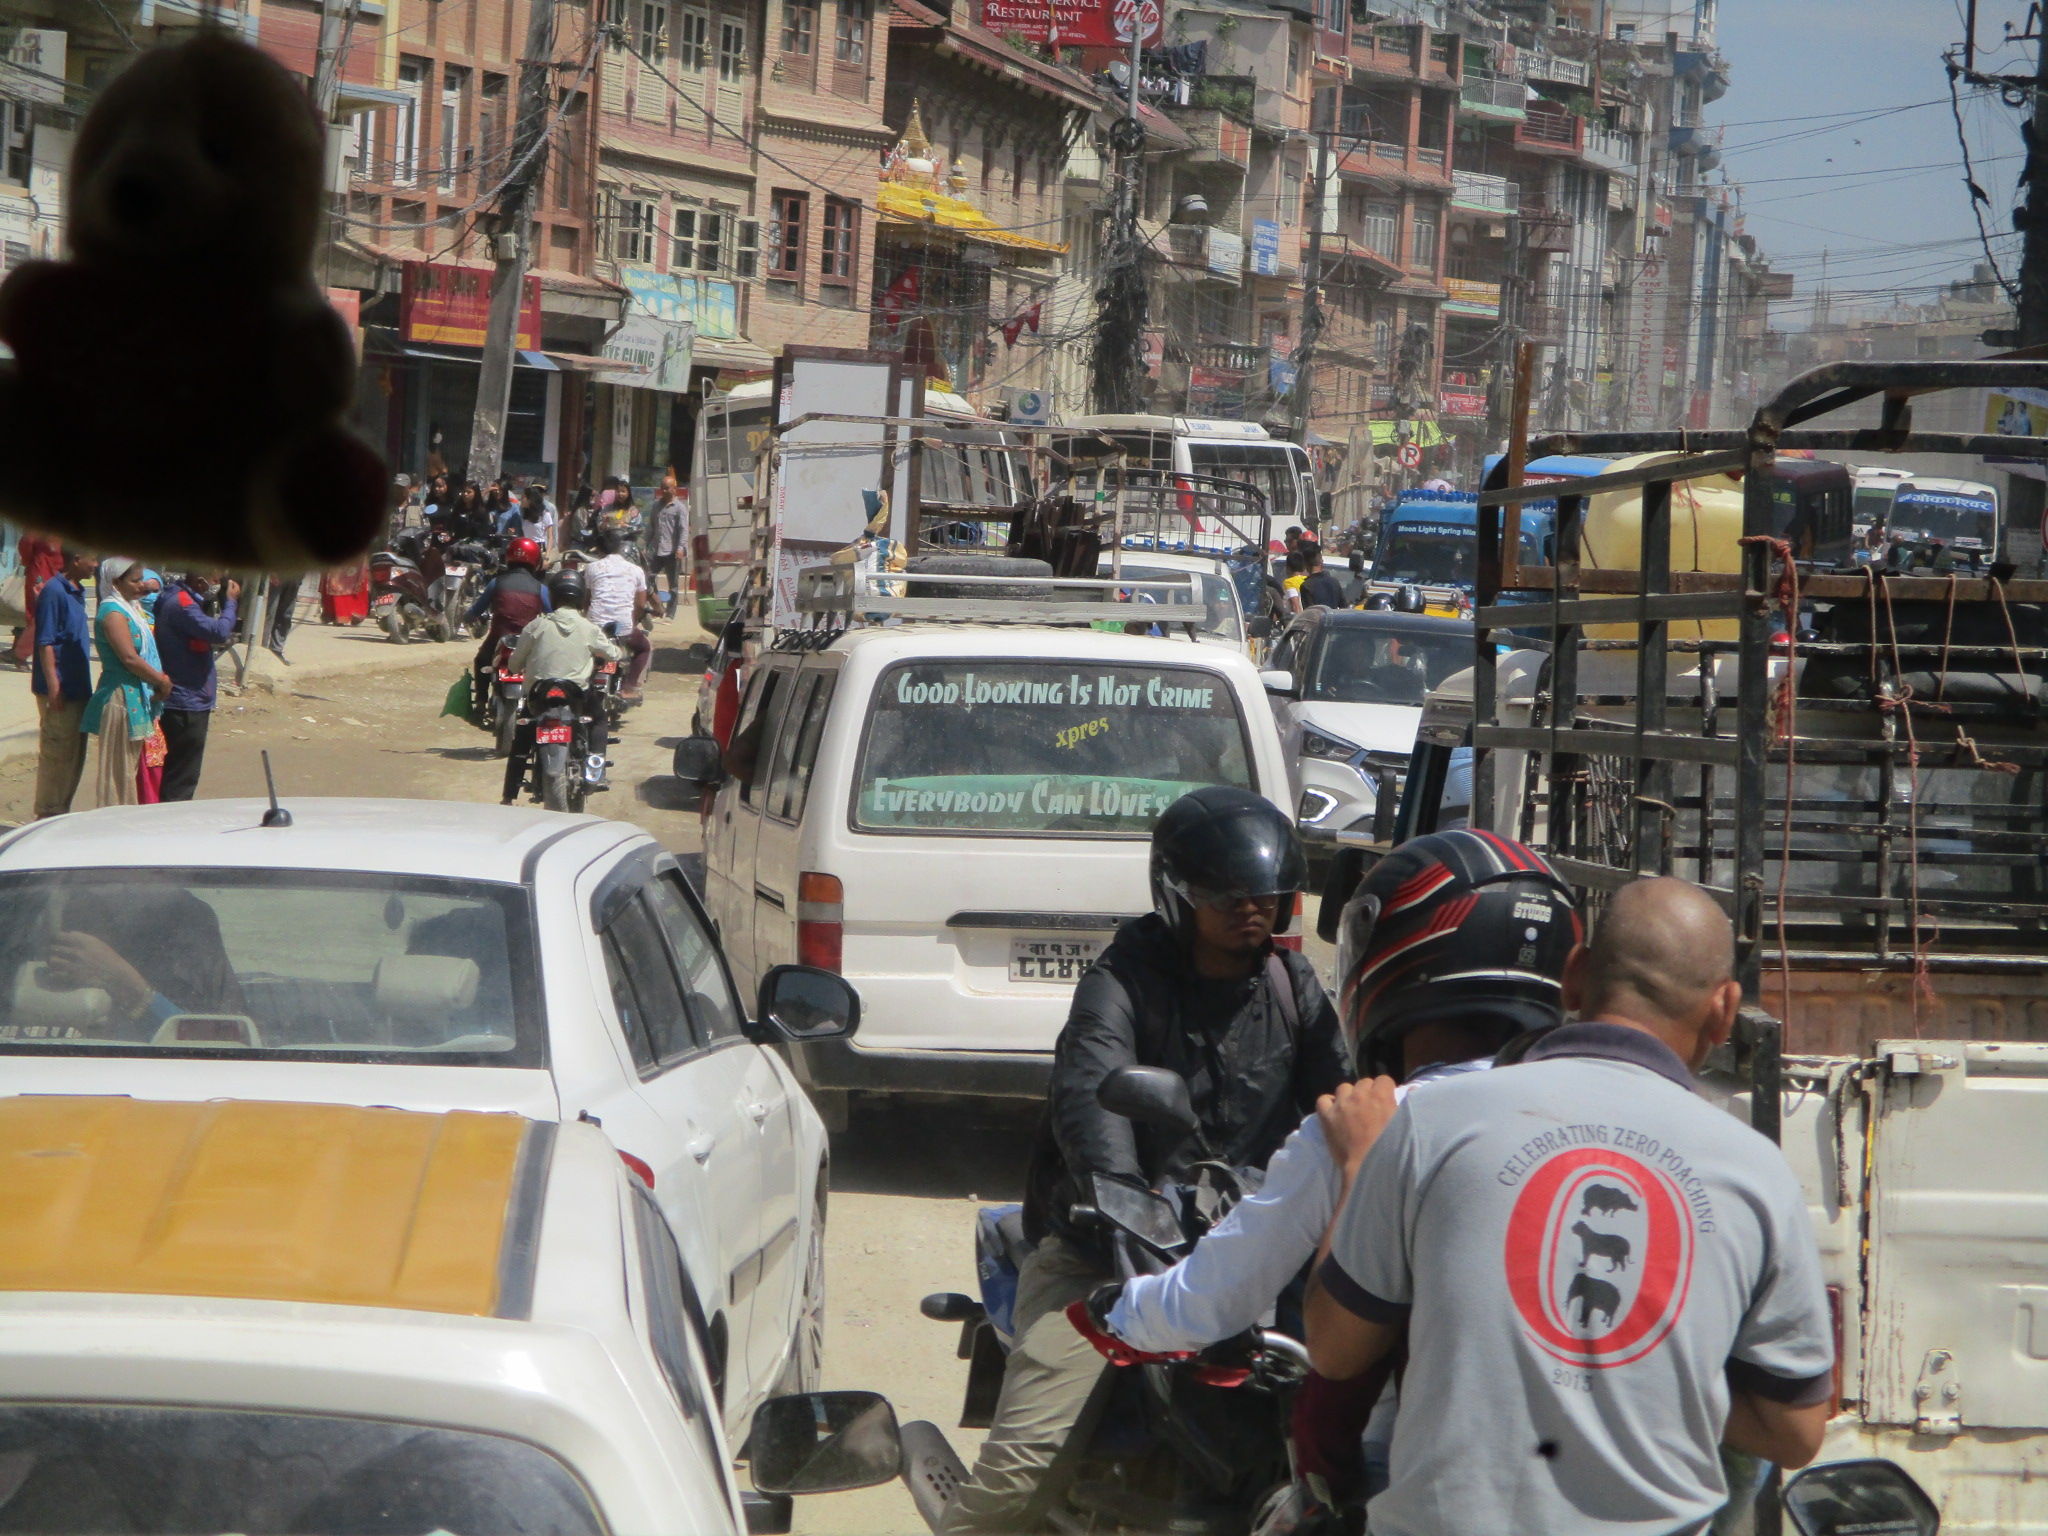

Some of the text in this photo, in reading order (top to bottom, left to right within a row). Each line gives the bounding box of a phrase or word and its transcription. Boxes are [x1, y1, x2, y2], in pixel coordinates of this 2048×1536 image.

[987, 3, 1083, 22] RESTAURANT
[622, 347, 655, 368] CLINIC
[1398, 525, 1417, 533] Moon
[1418, 525, 1437, 534] Light
[1438, 526, 1461, 536] Spring
[897, 672, 1214, 710] GOOD LOOKING IS NOT CRIME
[873, 777, 1025, 813] EVERYBODY
[1031, 778, 1085, 816] CAN
[1497, 1124, 1717, 1234] CELEBRATING ZERO POACHING
